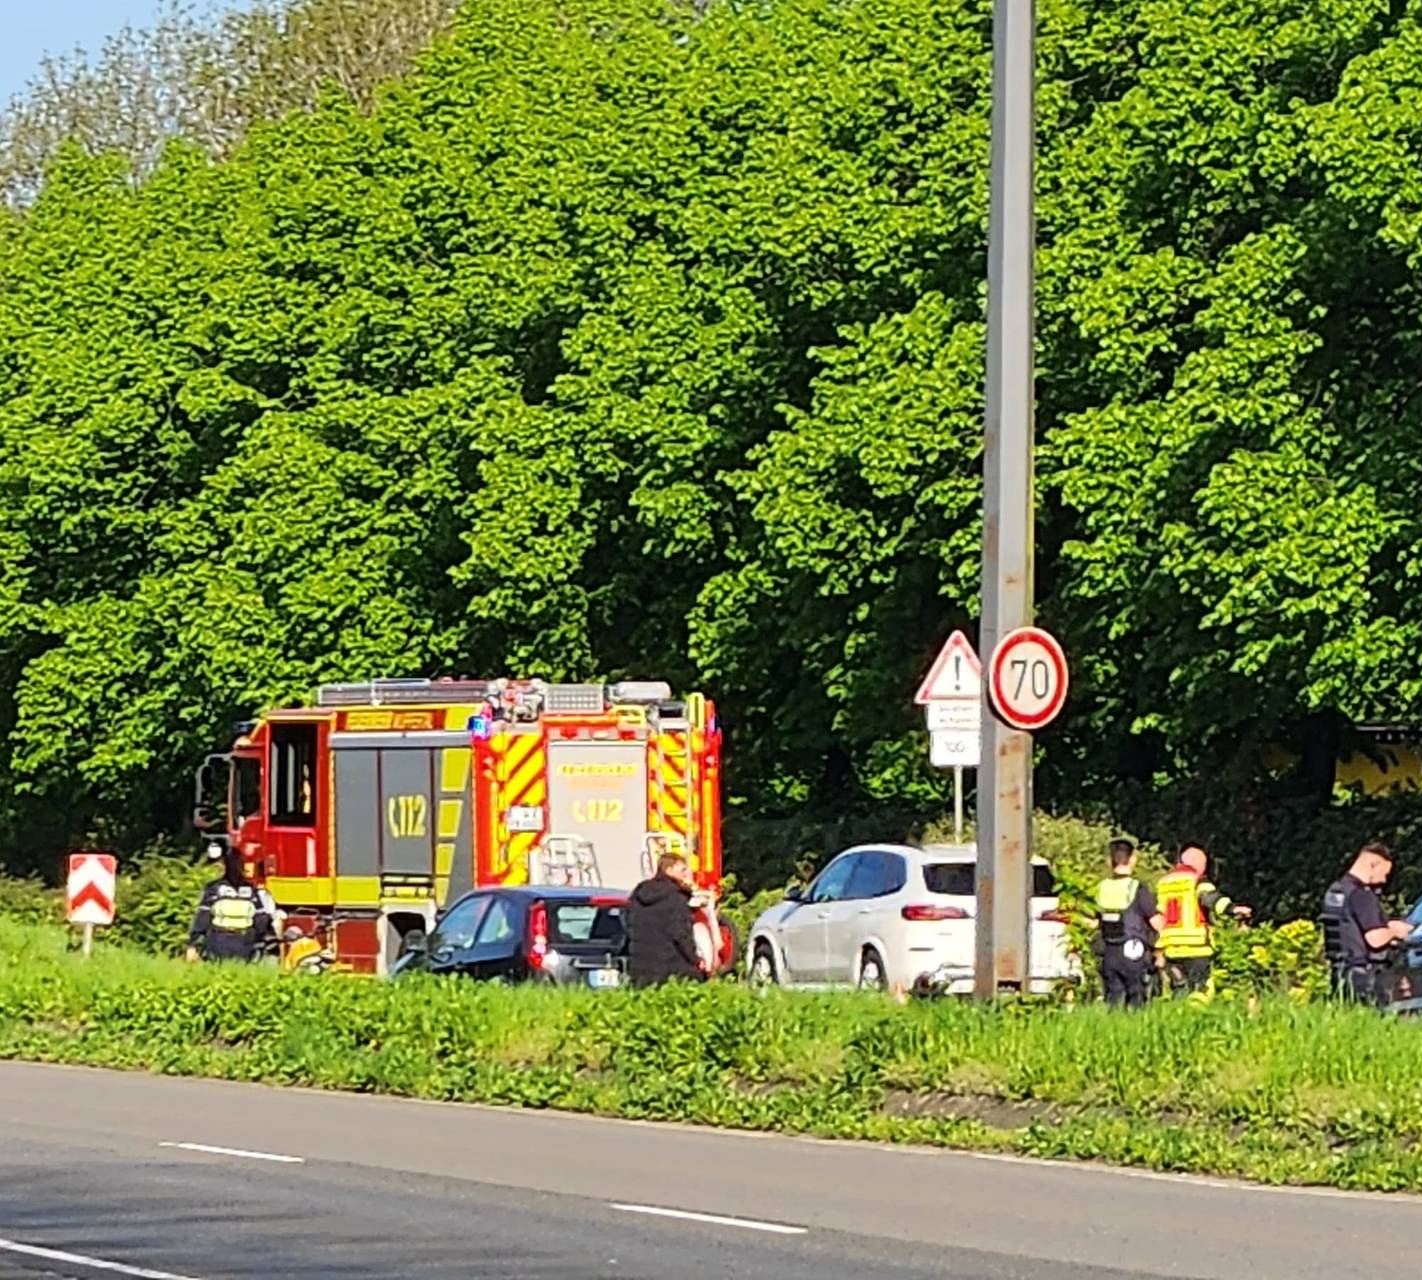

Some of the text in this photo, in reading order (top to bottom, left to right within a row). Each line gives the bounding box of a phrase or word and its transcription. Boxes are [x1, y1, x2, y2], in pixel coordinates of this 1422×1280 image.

[1011, 660, 1048, 700] 70
[399, 795, 426, 836] 112
[588, 799, 623, 821] 112
